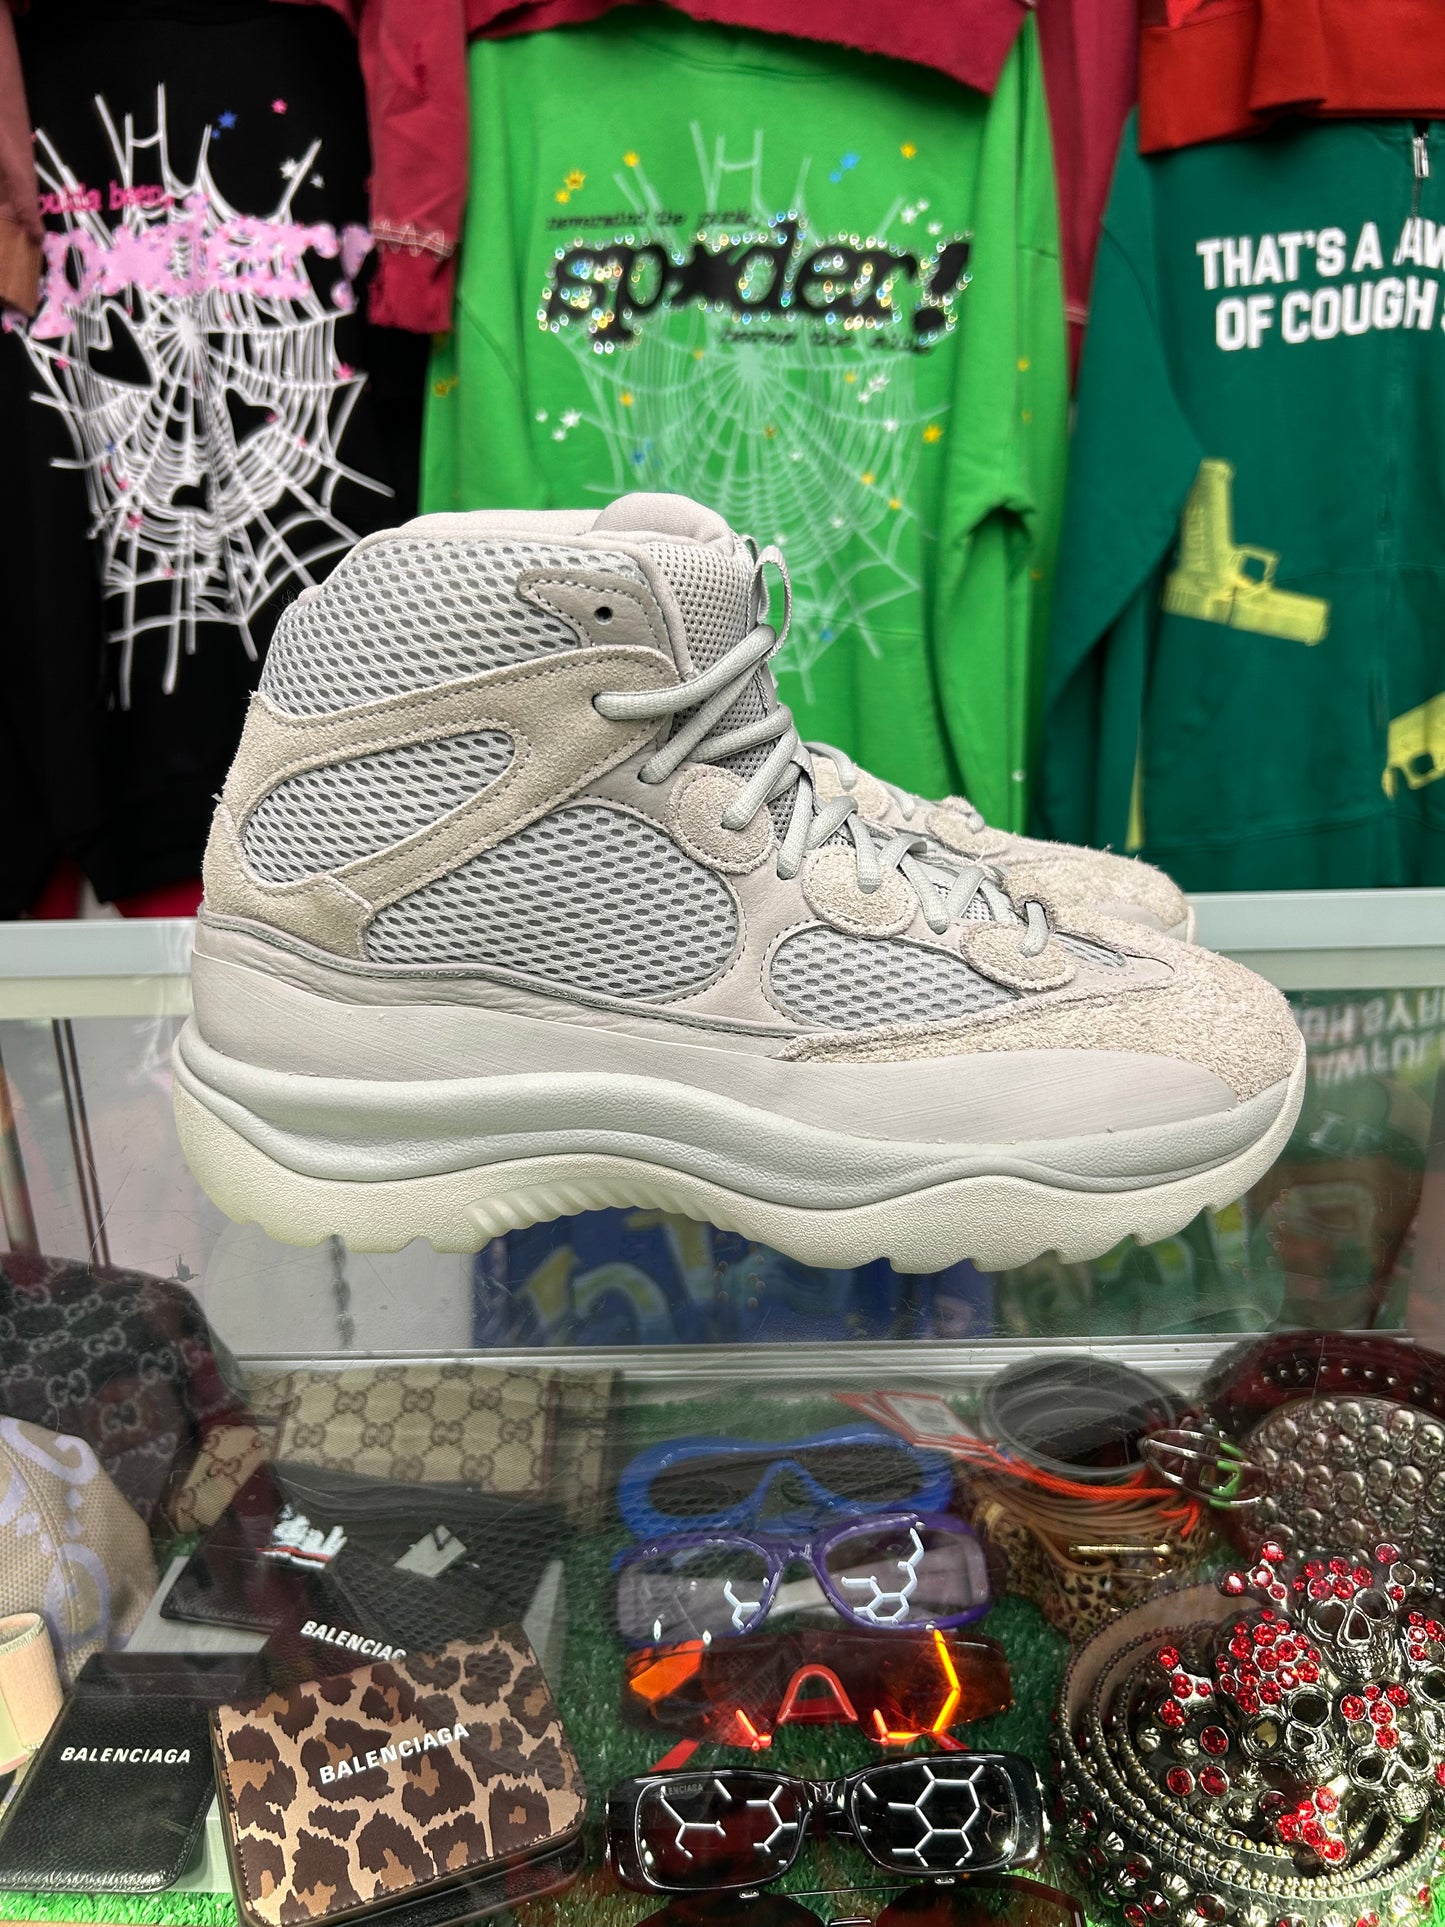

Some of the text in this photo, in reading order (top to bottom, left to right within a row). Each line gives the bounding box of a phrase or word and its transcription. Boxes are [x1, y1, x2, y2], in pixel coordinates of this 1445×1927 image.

[1196, 226, 1347, 290] THAT'S
[1351, 221, 1384, 273] A
[1215, 294, 1275, 351] OF
[1281, 275, 1438, 344] COUGH
[60, 1747, 191, 1764] BALENCIAGA
[319, 1722, 470, 1784] BALENCIAGA
